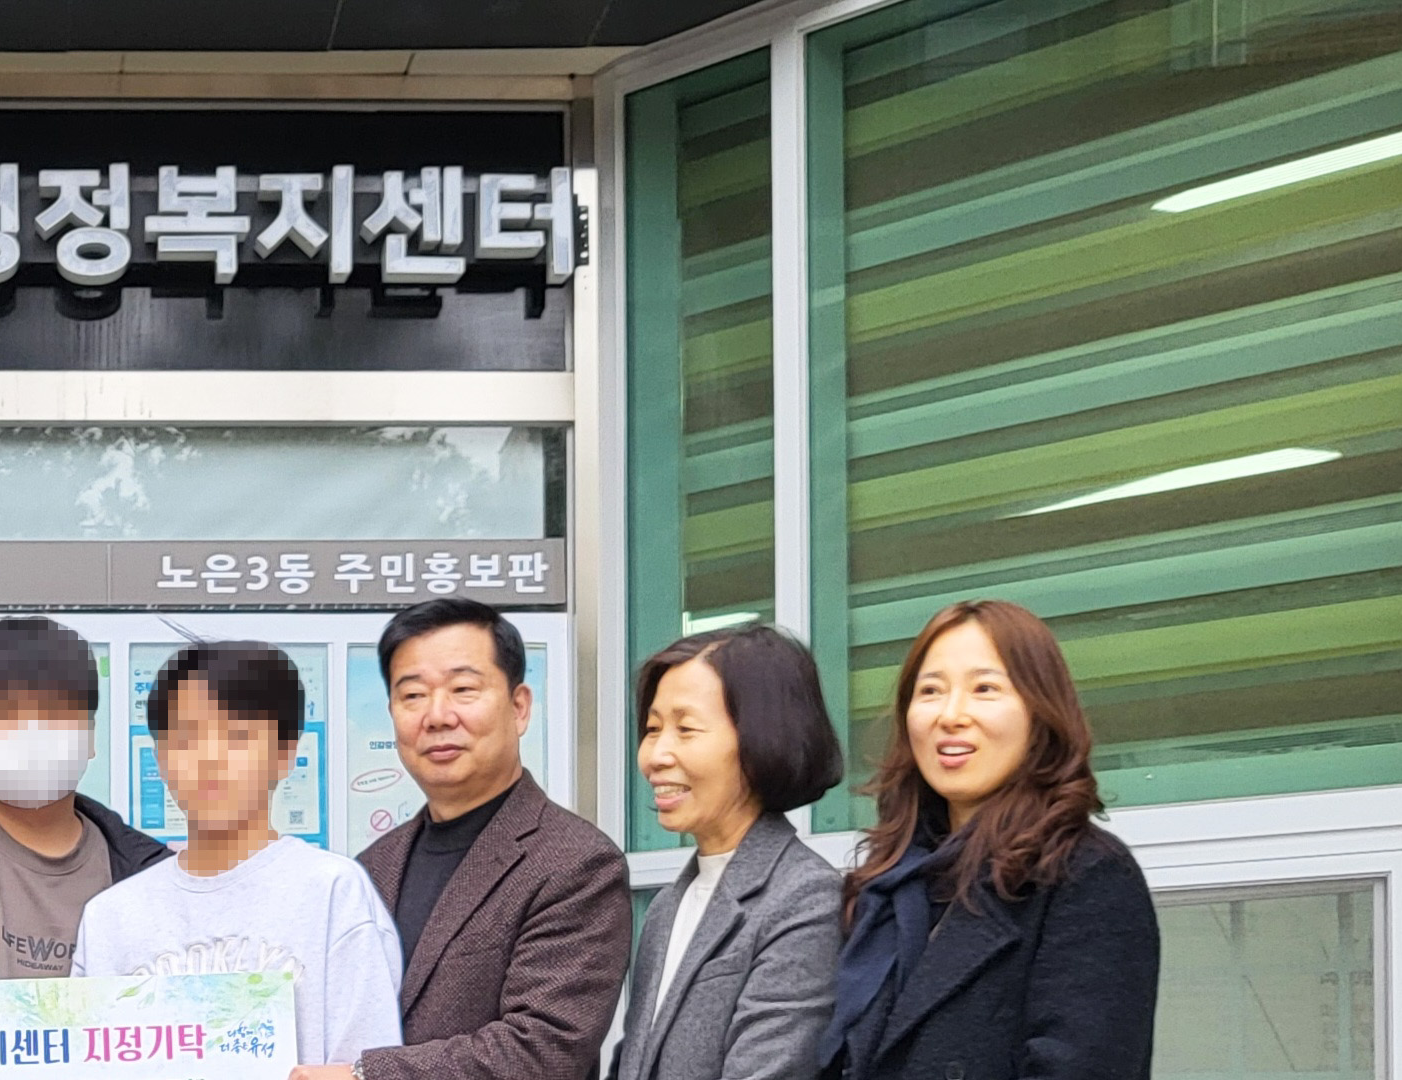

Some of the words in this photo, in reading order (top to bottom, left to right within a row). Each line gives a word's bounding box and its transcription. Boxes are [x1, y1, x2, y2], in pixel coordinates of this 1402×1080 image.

[156, 554, 316, 594] 노은3동
[333, 552, 550, 594] 주민홍보판
[82, 1024, 207, 1063] 지정기탁
